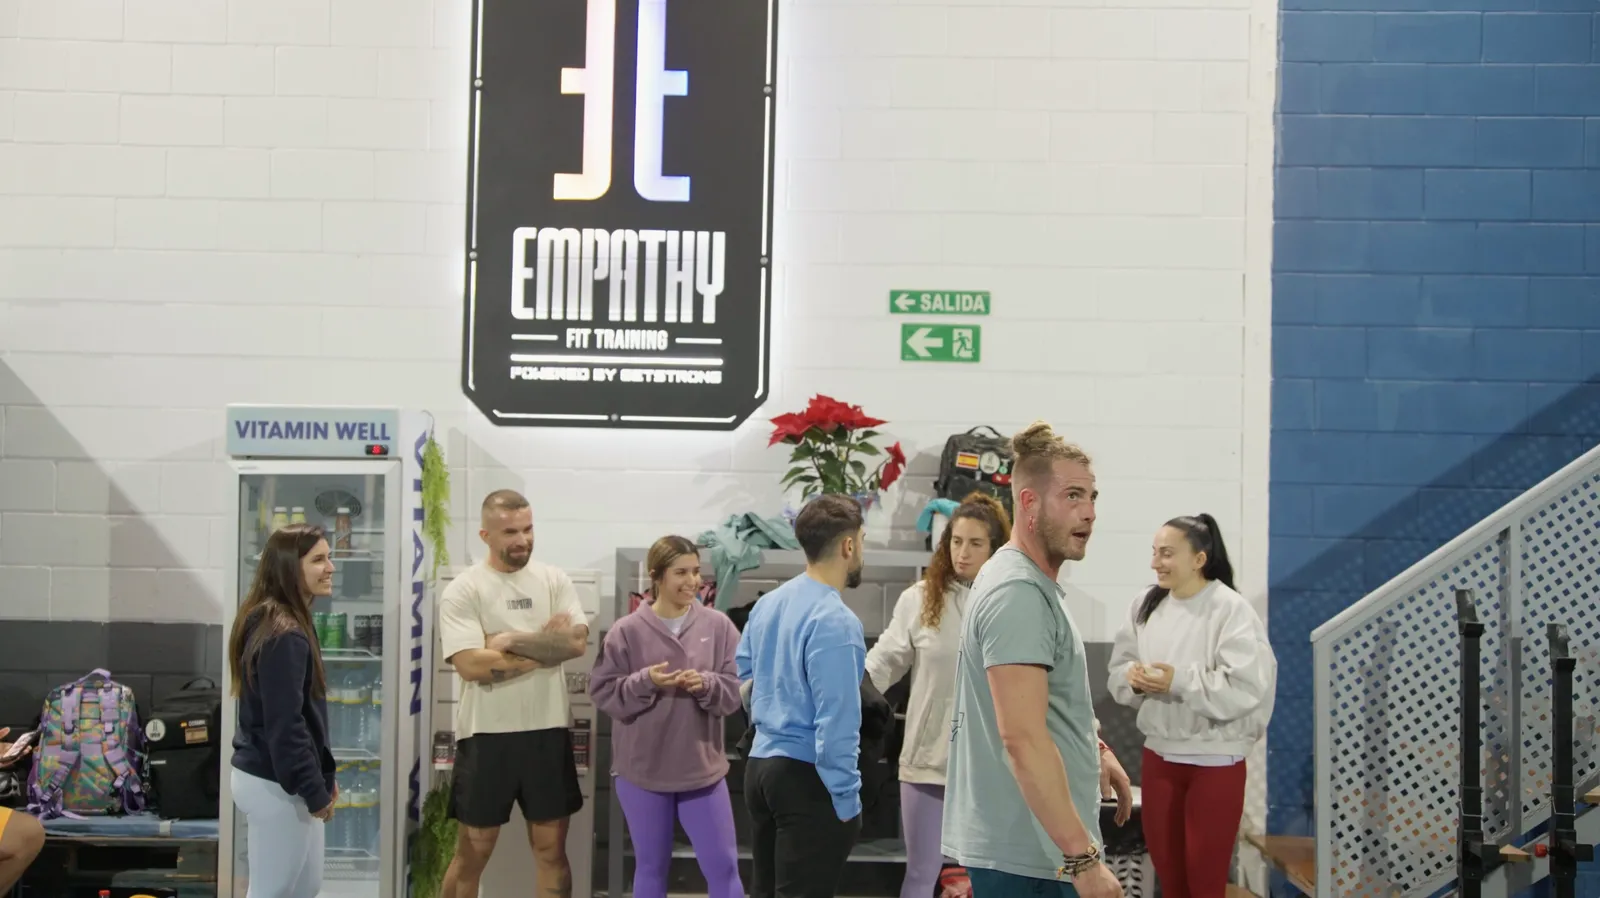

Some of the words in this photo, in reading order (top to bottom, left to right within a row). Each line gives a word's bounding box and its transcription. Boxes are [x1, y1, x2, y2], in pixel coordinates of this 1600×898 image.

[511, 227, 725, 323] EMPATHY
[920, 293, 985, 312] SALIDA
[566, 328, 591, 348] FIT
[594, 328, 668, 350] TRAINING
[510, 366, 590, 381] POWERED
[593, 368, 617, 381] BY
[235, 420, 329, 440] VITAMIN
[335, 421, 391, 440] WELL
